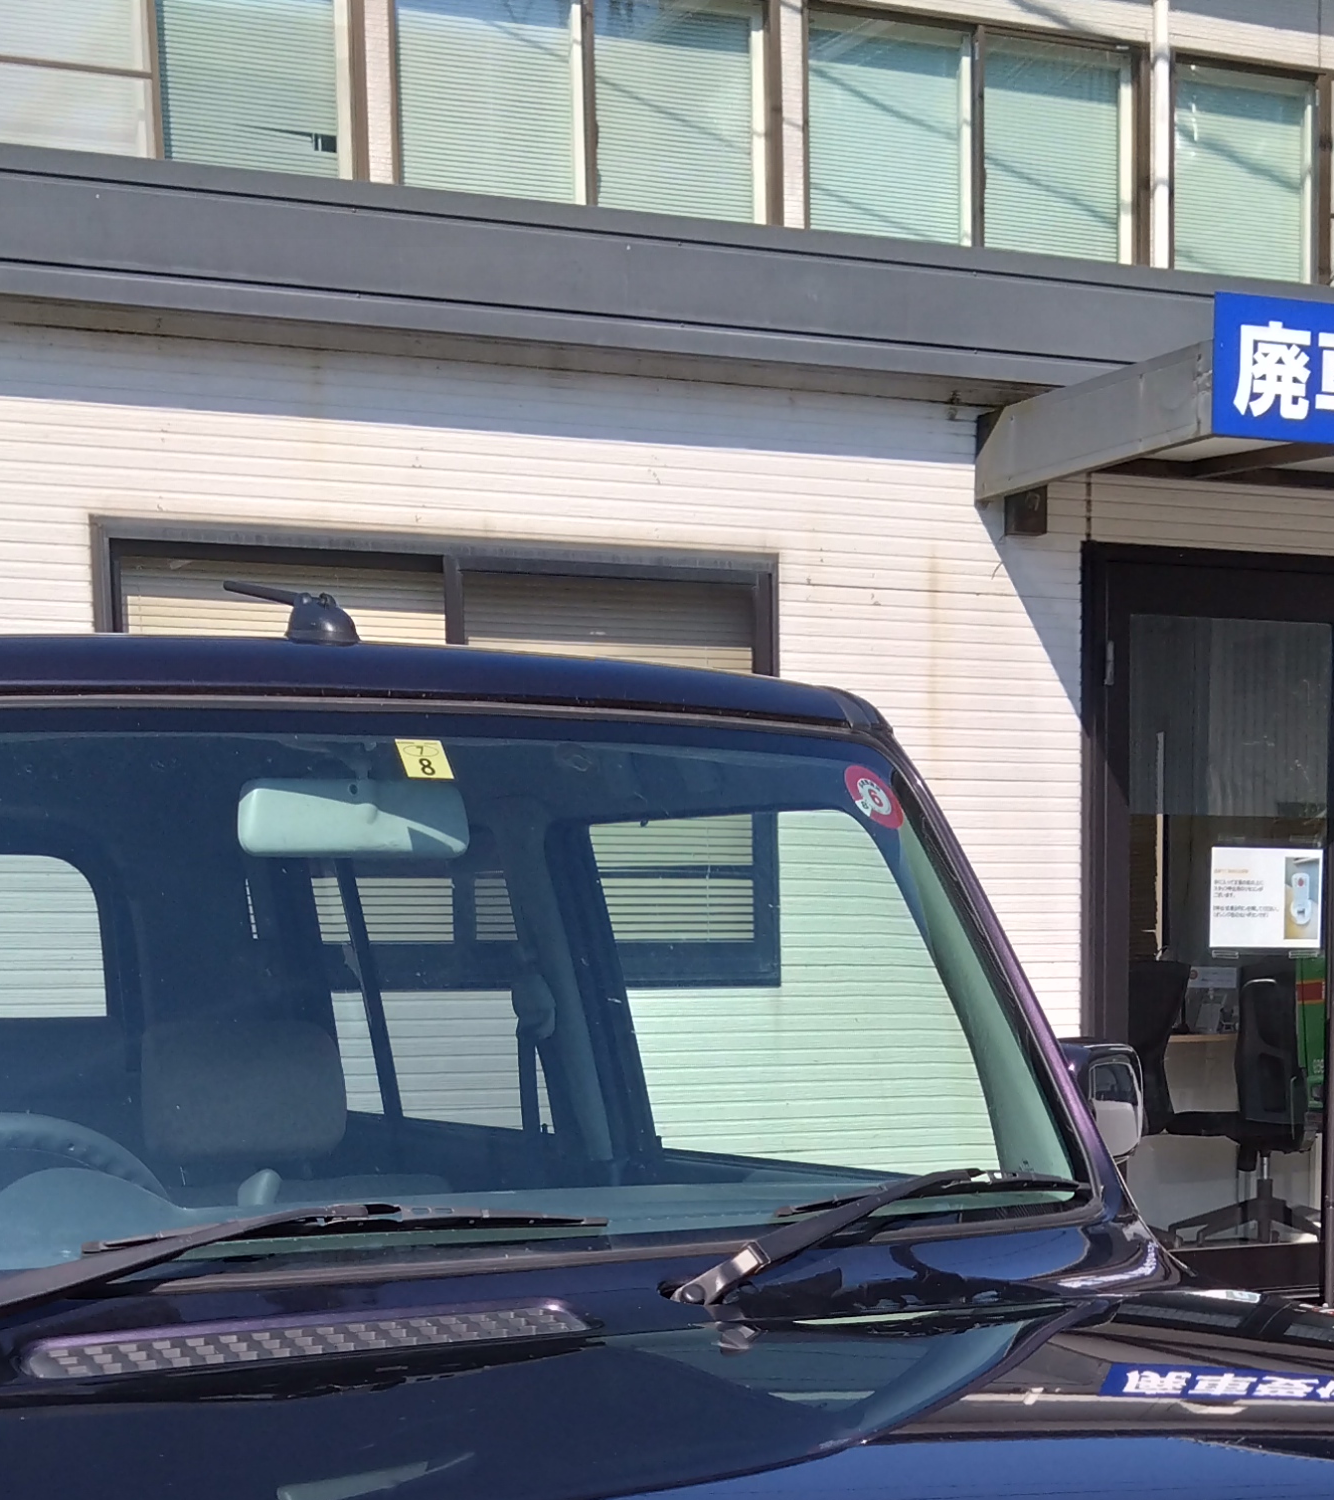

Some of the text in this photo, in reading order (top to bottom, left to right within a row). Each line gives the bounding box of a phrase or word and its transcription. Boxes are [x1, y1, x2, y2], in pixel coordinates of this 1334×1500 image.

[415, 745, 424, 756] 7
[418, 758, 436, 776] 8
[867, 788, 884, 808] 6
